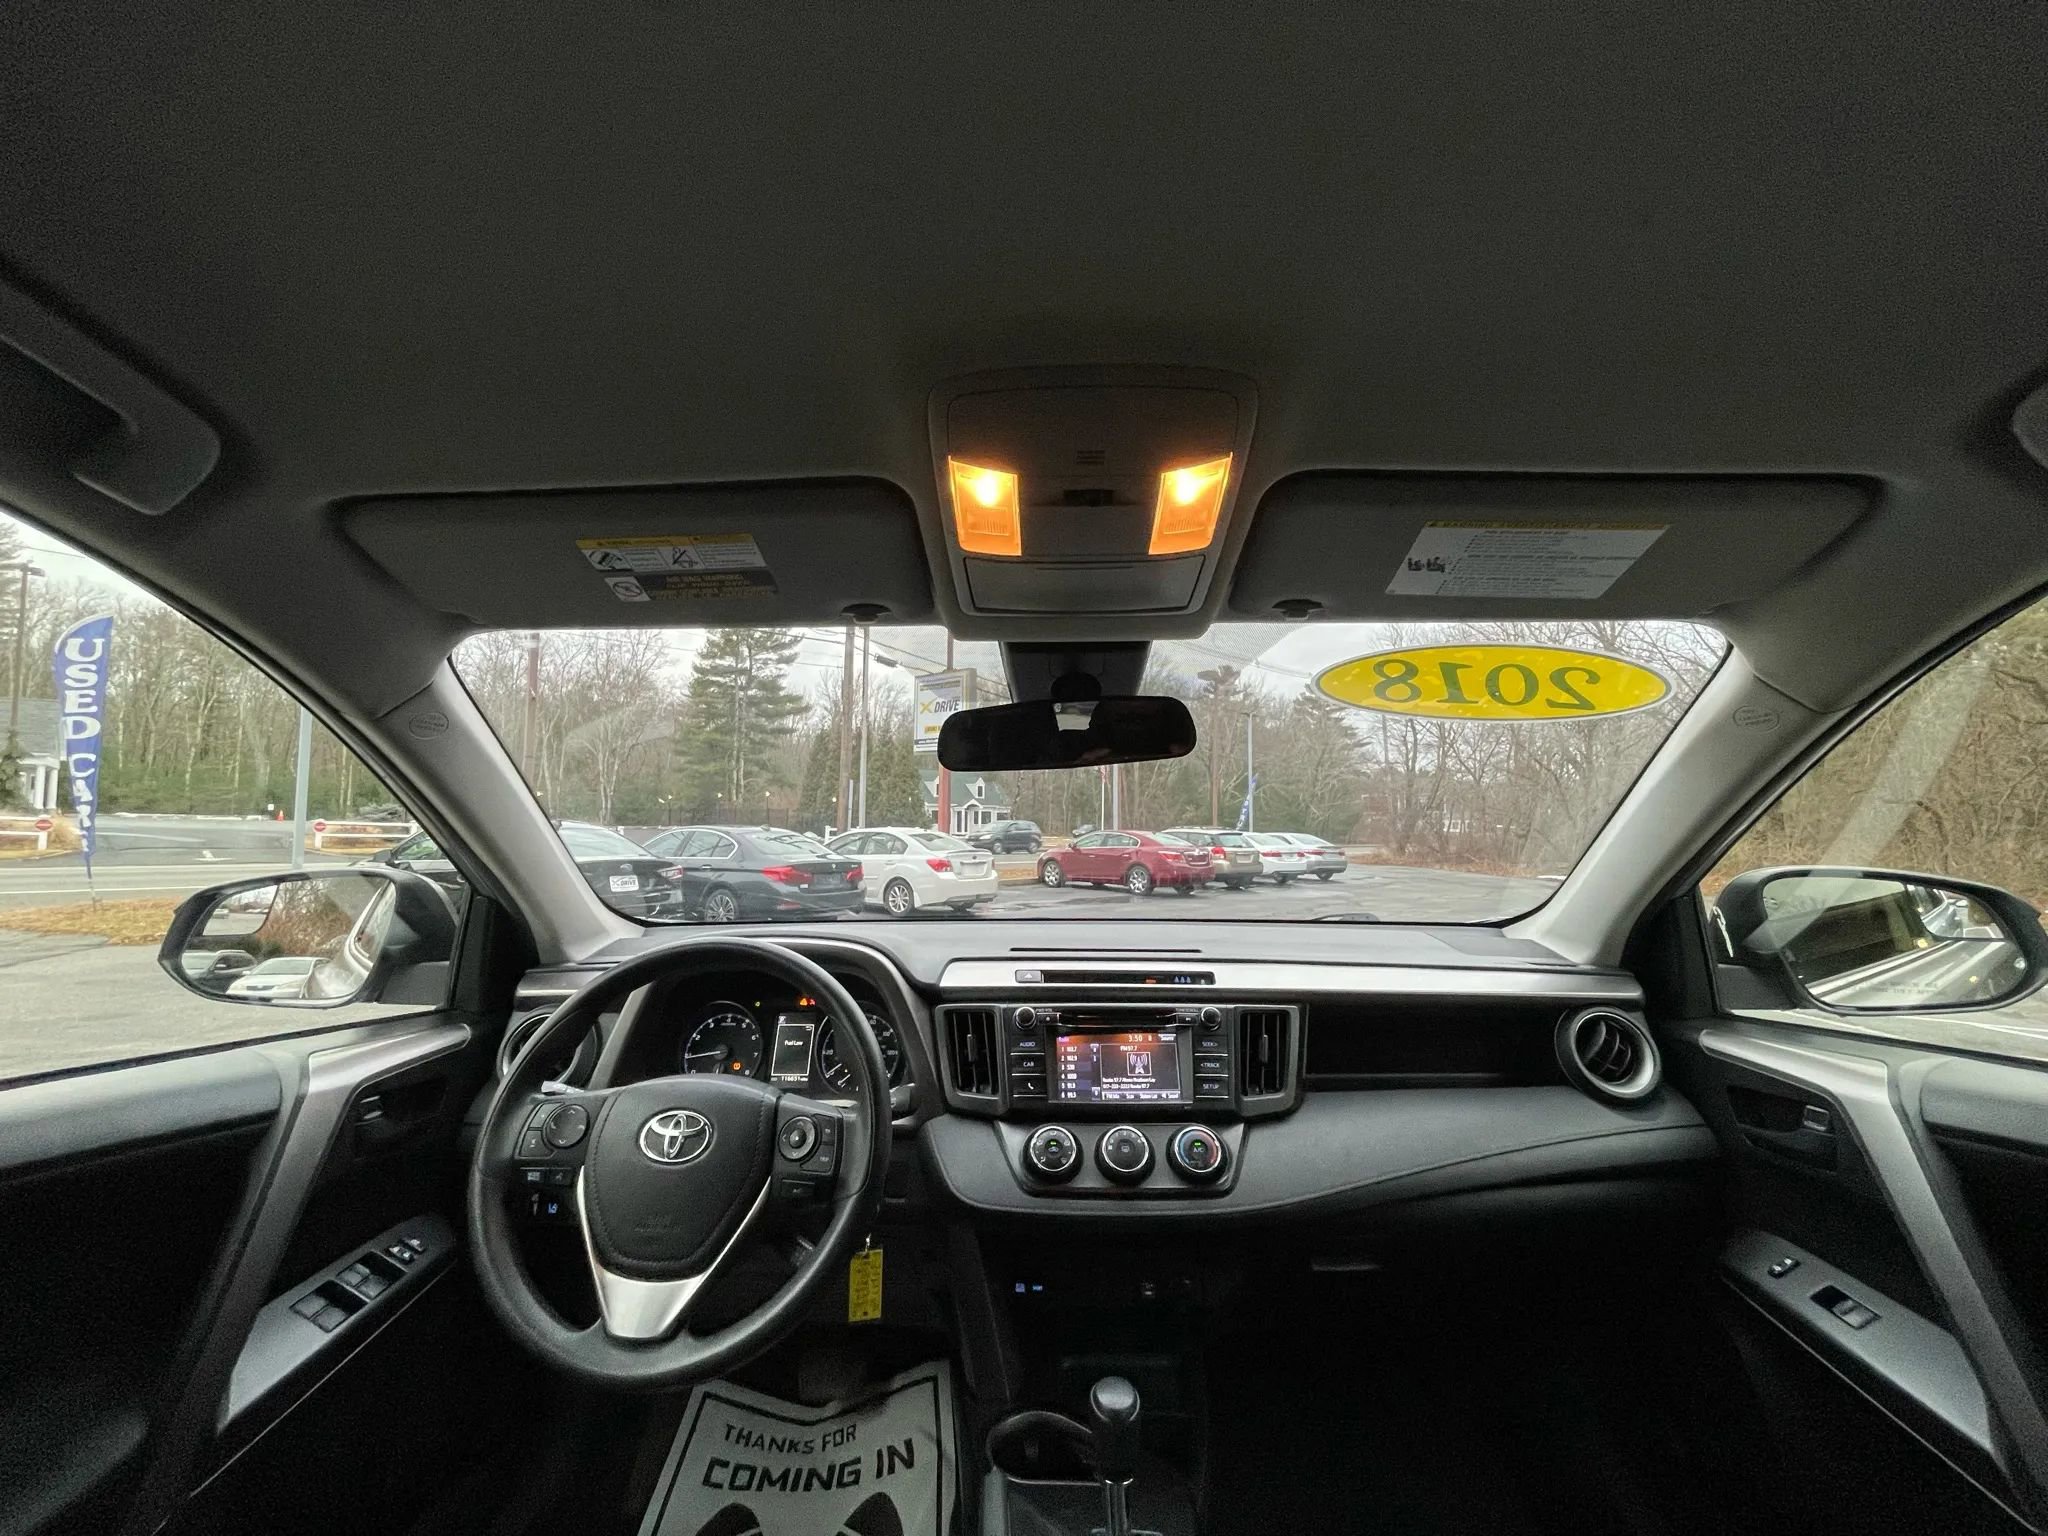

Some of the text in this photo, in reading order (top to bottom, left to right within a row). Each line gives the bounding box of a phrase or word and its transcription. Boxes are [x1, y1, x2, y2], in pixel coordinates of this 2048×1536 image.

[62, 638, 105, 739] USED
[934, 700, 960, 713] DRIVE
[723, 1423, 857, 1455] THANKS FOR
[702, 1437, 915, 1493] COMING IN
